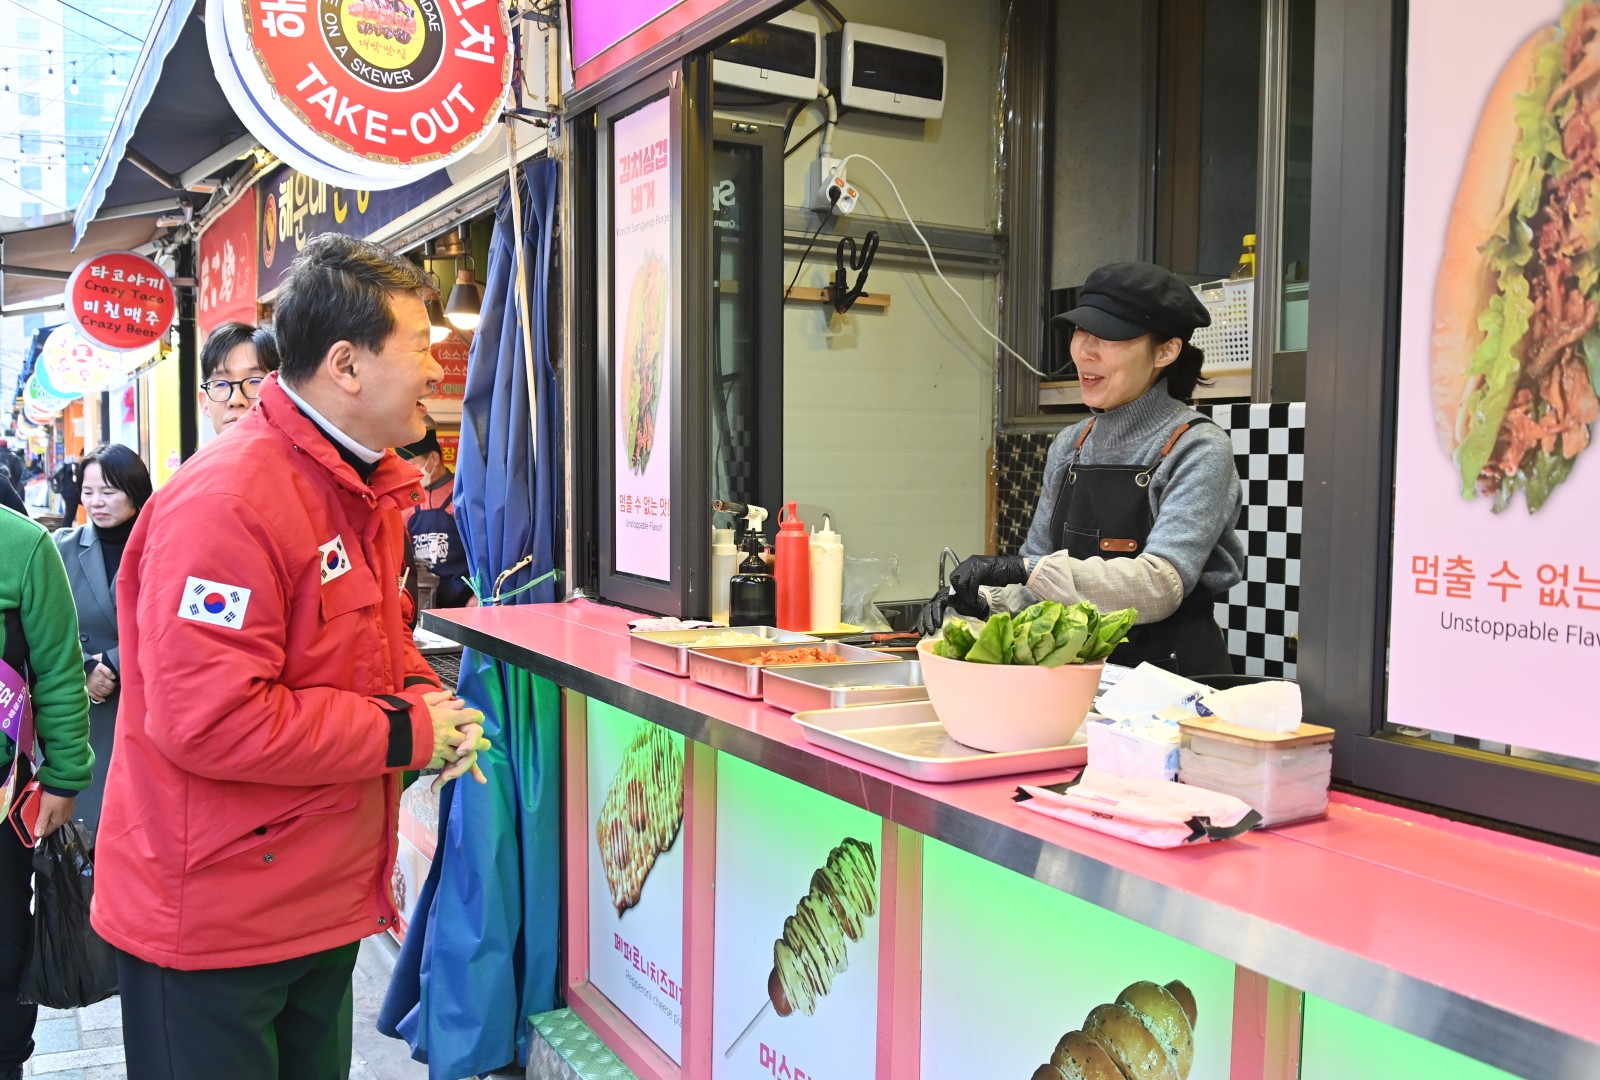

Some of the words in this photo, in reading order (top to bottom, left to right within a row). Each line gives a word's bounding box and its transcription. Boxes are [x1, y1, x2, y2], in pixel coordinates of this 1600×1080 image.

[324, 12, 340, 37] ON
[335, 45, 349, 58] A
[350, 58, 414, 85] SKEWER
[295, 62, 475, 145] TAKE-OUT
[619, 138, 668, 185] 김치삼겹
[631, 180, 655, 215] 버거
[84, 279, 125, 299] Crazy
[131, 289, 165, 304] Taco
[90, 265, 165, 291] 타코야끼
[81, 315, 122, 334] Crazy
[126, 323, 158, 338] Beer
[619, 494, 633, 514] 멈출
[634, 495, 642, 515] 수
[643, 496, 658, 516] 없는
[1411, 555, 1476, 599] 멈출
[1487, 560, 1522, 602] 수
[1536, 563, 1600, 611] 없는
[1440, 610, 1559, 643] Unstoppable
[625, 969, 653, 1002] Pepperoni
